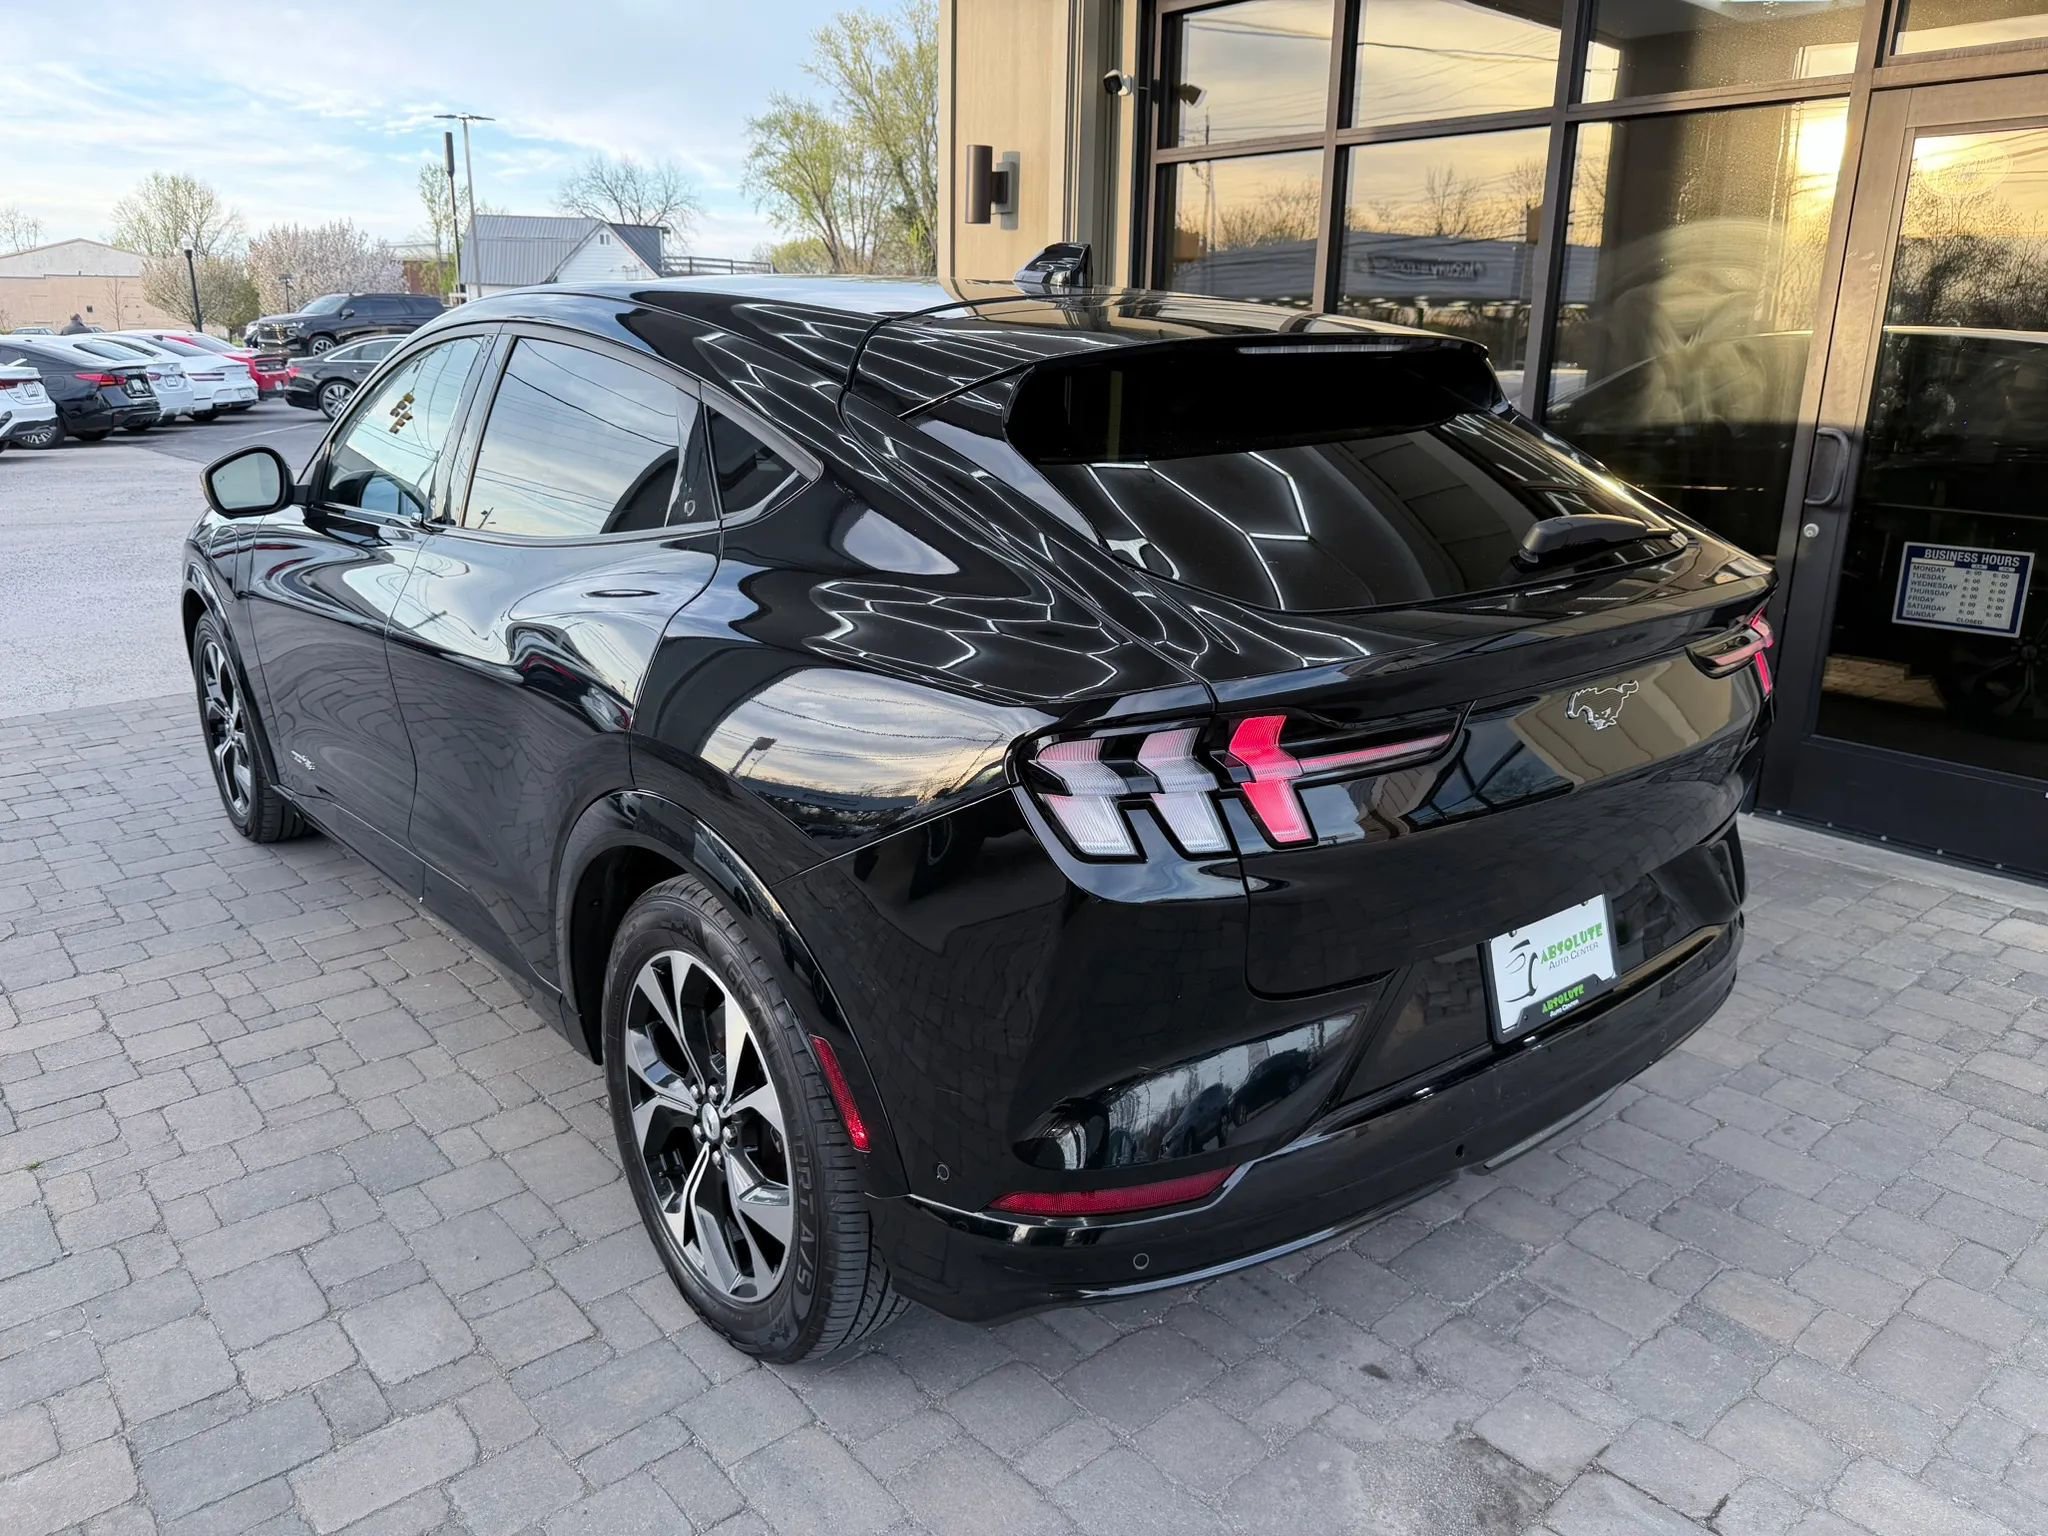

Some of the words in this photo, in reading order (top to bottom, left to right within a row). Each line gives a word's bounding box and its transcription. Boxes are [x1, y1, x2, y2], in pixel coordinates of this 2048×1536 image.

[1924, 549, 1978, 563] BUSINESS
[1982, 554, 2020, 567] HOURS
[1912, 573, 1946, 581] TUESDAY
[1913, 565, 1946, 573] MONDAY
[1911, 581, 1957, 590] WEDNESDAY
[1541, 922, 1603, 964] ABSOLUTE
[1549, 956, 1570, 970] AUTO
[1571, 941, 1599, 960] CENTER
[1542, 984, 1585, 1014] ABSOLUTE
